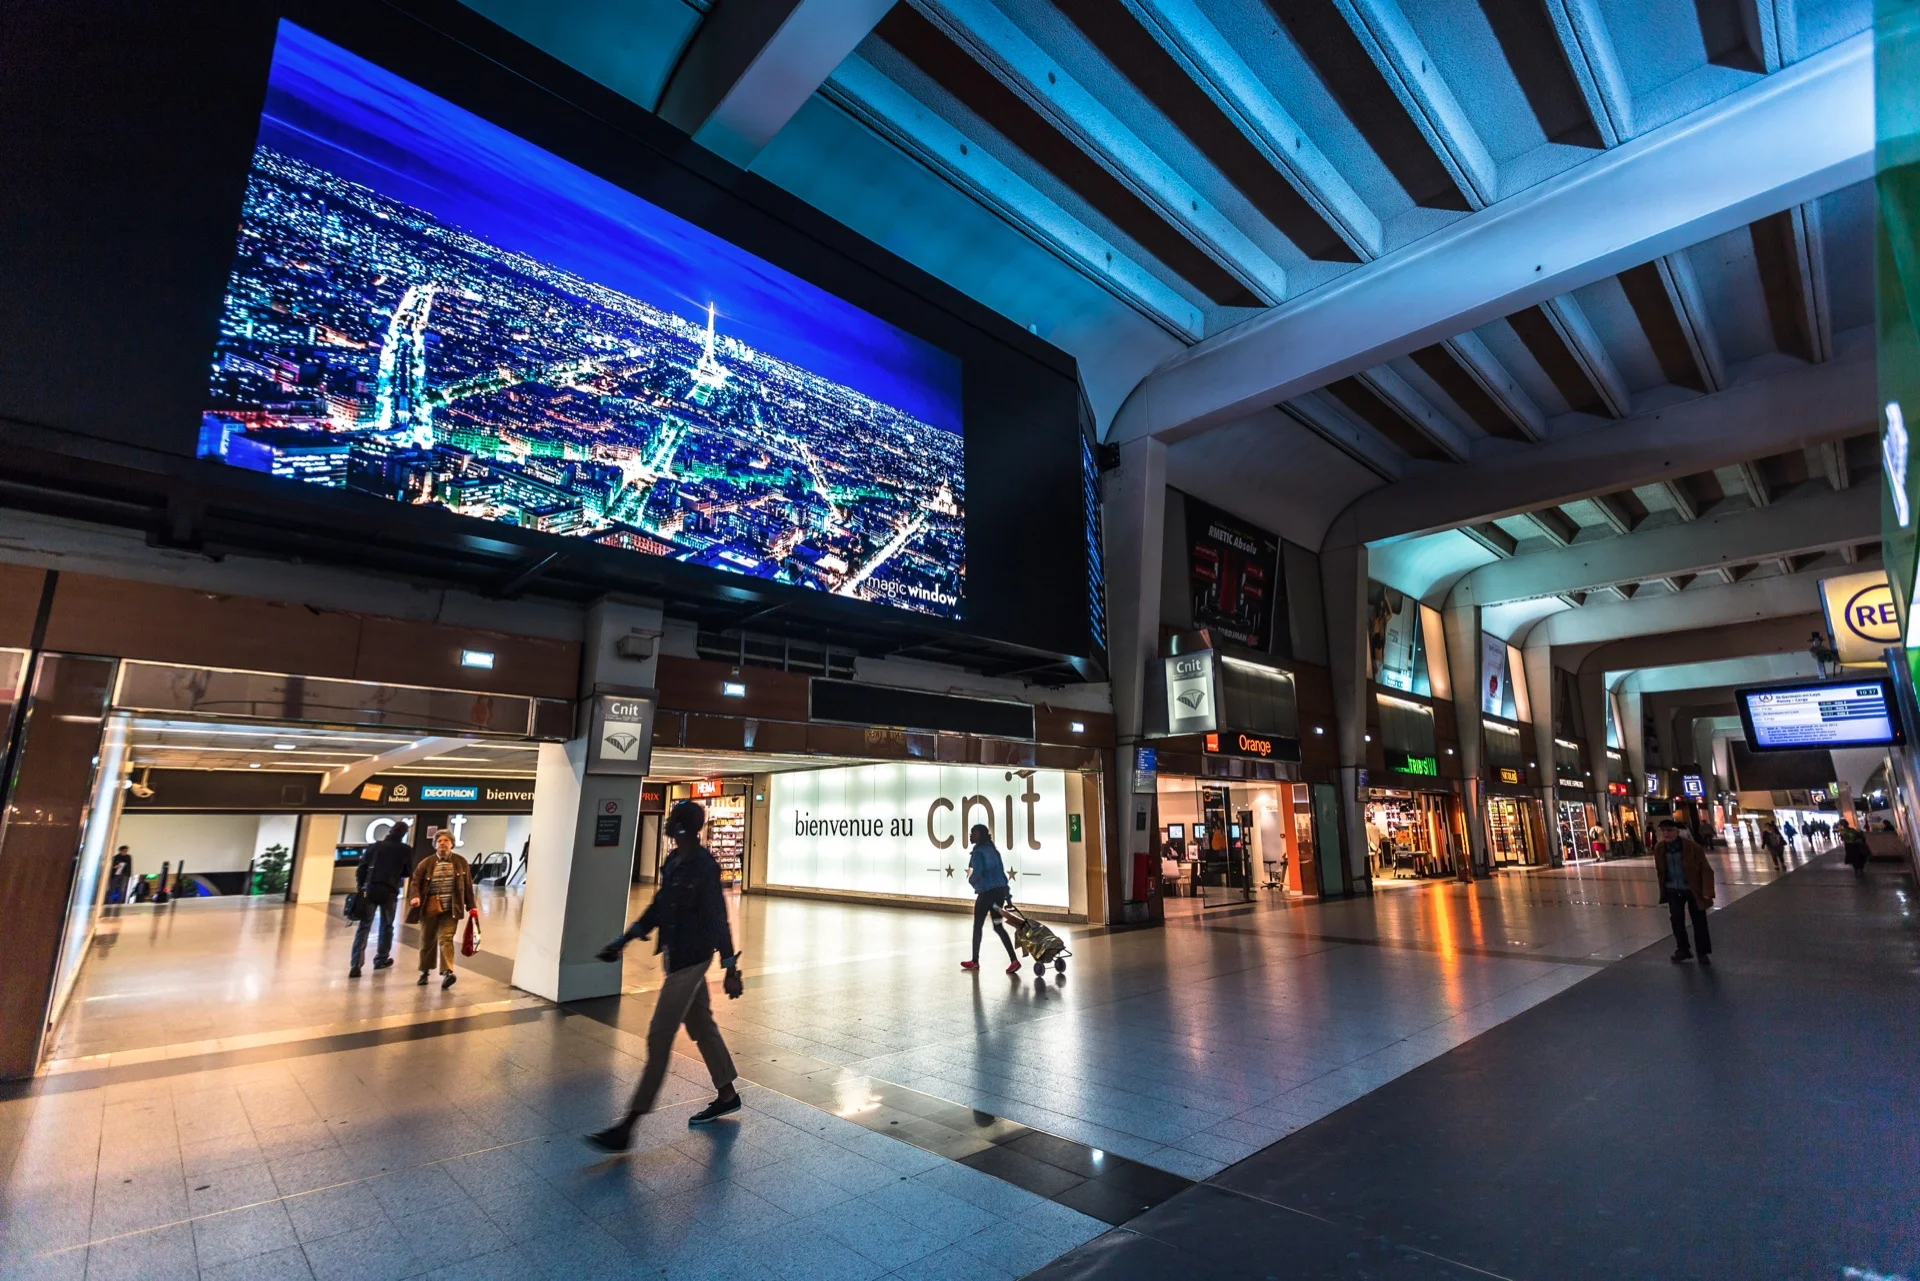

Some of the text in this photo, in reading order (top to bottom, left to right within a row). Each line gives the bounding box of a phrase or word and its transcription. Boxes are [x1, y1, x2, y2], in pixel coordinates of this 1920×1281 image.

[1233, 536, 1258, 555] Absolu
[867, 576, 957, 607] magic window
[1176, 659, 1202, 674] Cnit
[611, 702, 639, 717] Cnit
[1239, 734, 1272, 757] Orange
[424, 788, 475, 798] DECATHLON
[697, 781, 716, 795] HEMA
[795, 771, 1042, 850] bienvenue au cnit
